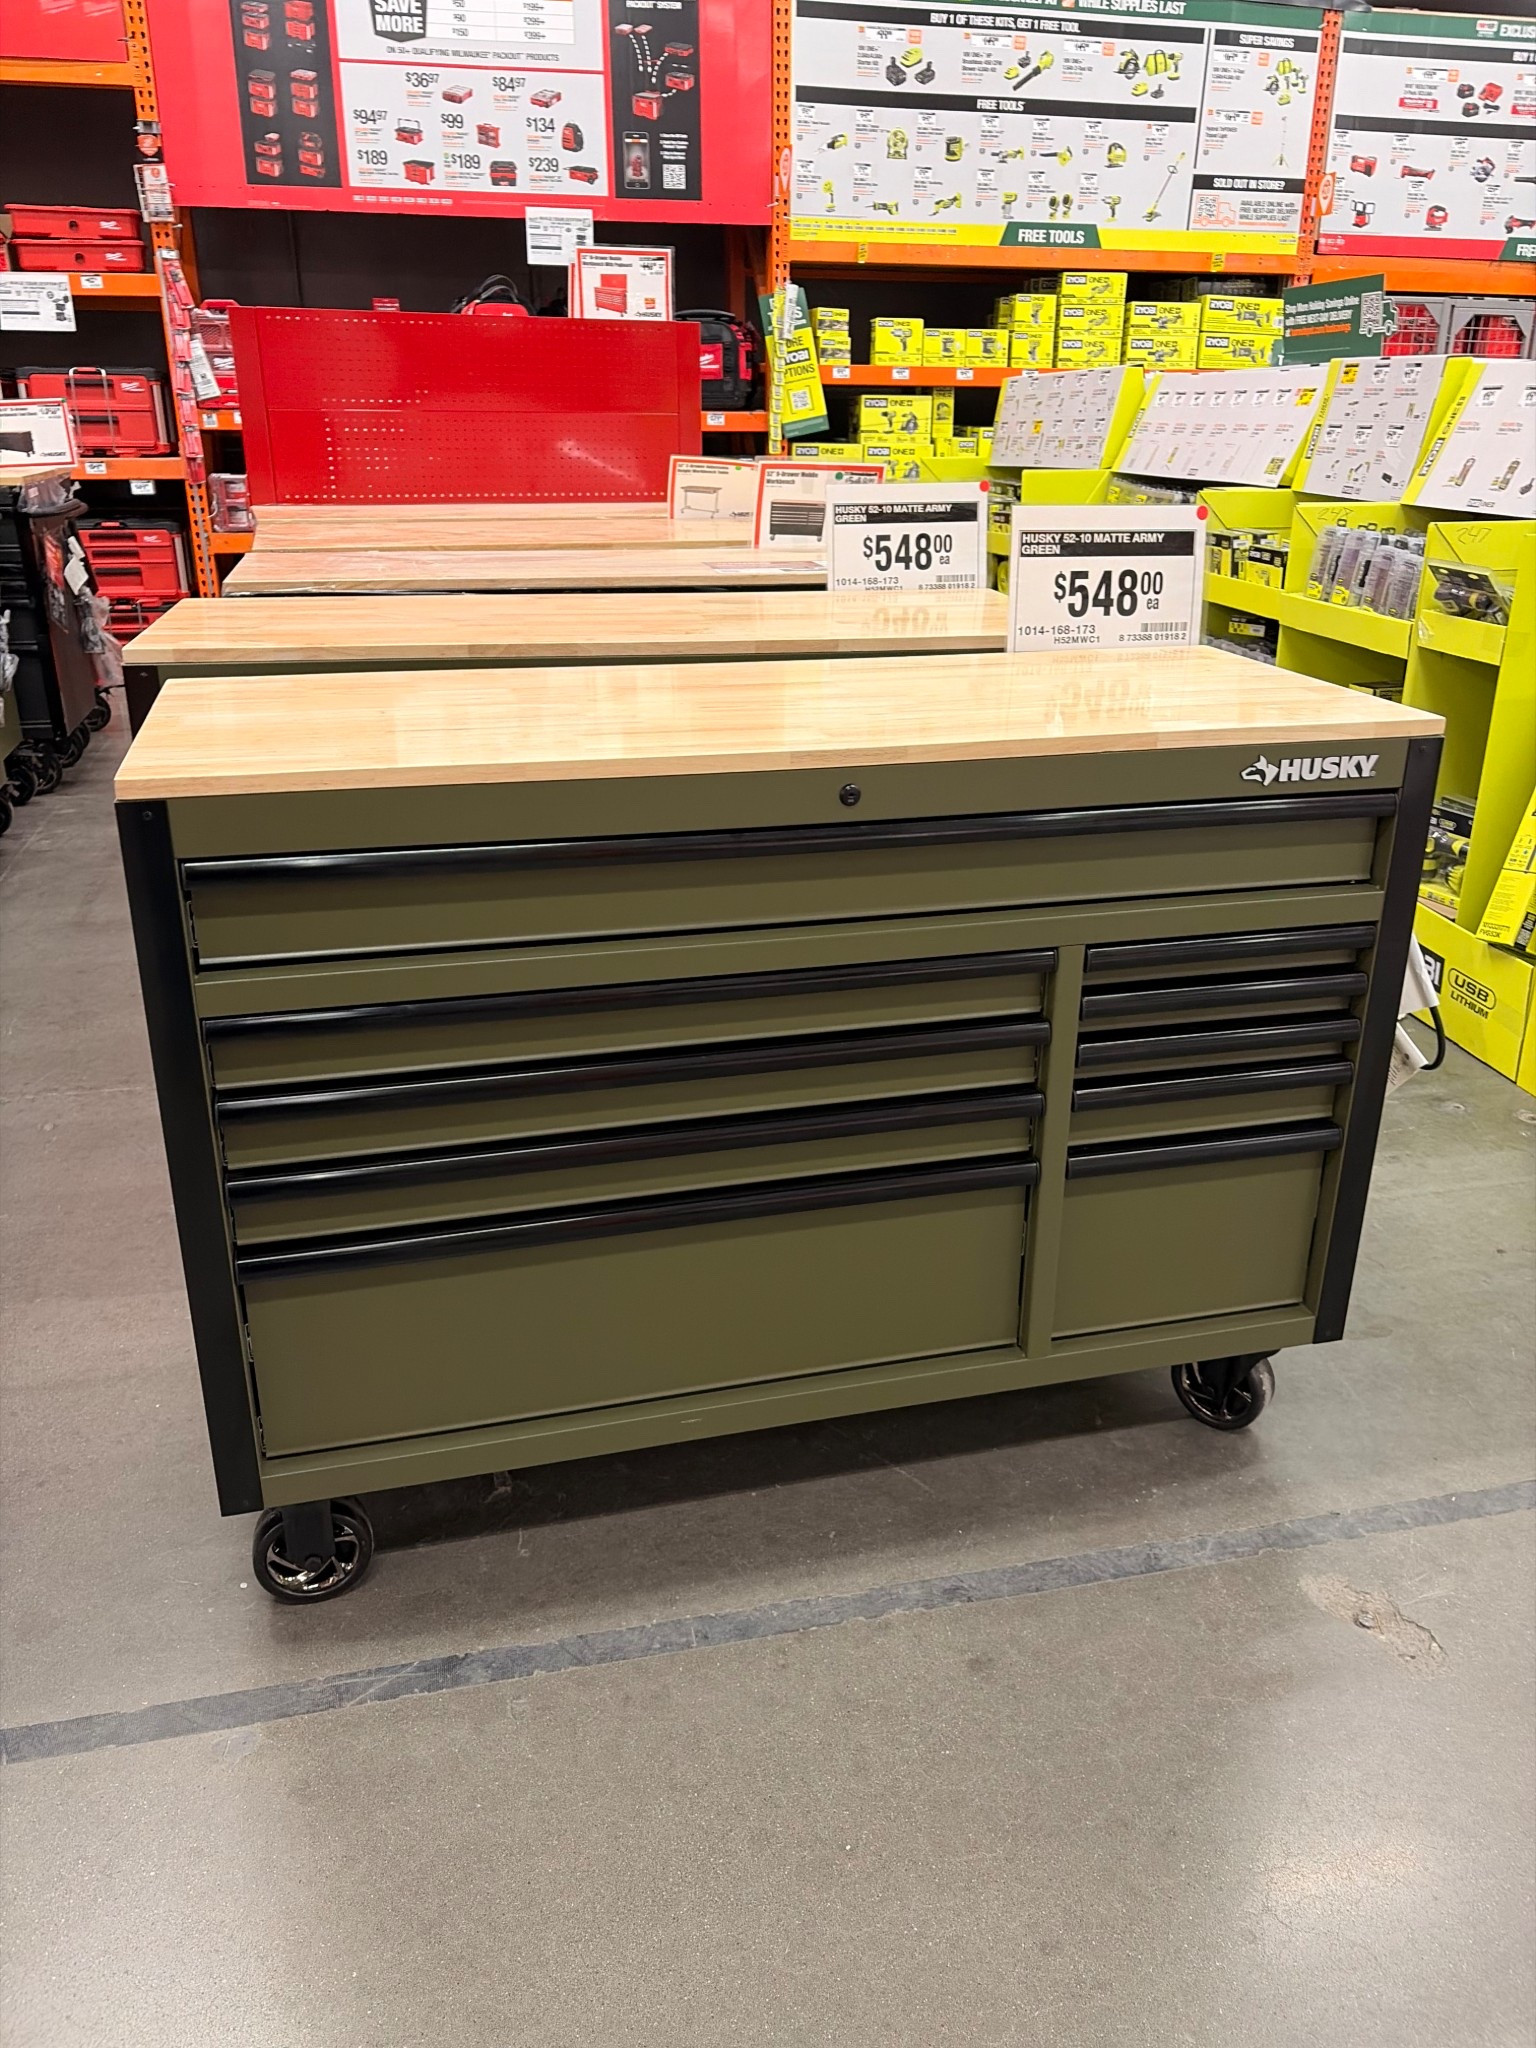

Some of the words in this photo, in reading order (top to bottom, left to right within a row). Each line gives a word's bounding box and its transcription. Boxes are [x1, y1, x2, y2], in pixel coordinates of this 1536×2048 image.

[374, 0, 422, 14] SAVE
[1110, 0, 1158, 13] SUPPLIES
[1159, 1, 1187, 14] LAST
[375, 14, 424, 33] MORE
[930, 12, 948, 23] BUY
[949, 14, 954, 24] 1
[956, 14, 968, 25] OF
[969, 15, 994, 27] THESE
[1017, 18, 1033, 29] GET
[1040, 20, 1060, 31] FREE
[1061, 21, 1081, 33] TOOL
[1239, 34, 1263, 45] SUPER
[1263, 36, 1295, 48] SAVINGS
[977, 99, 998, 110] FREE
[441, 113, 464, 129] $99
[526, 117, 555, 132] $134
[358, 149, 388, 165] $189
[451, 154, 481, 169] $189
[529, 157, 559, 172] $239
[1213, 178, 1233, 188] SOLD
[1234, 179, 1248, 189] OUT
[1018, 229, 1048, 243] FREE
[1050, 230, 1084, 244] TOOLS
[786, 336, 803, 348] ORE
[785, 350, 809, 363] YOBI
[784, 364, 815, 378] PTIONS
[1419, 439, 1445, 475] RYOBI
[835, 506, 867, 514] HUSKY
[868, 505, 892, 513] 52-10
[893, 504, 924, 513] MATTE
[925, 504, 952, 513] ARMY
[1022, 533, 1061, 543] HUSKY
[1063, 533, 1092, 543] 52-10
[1093, 532, 1131, 543] MATTE
[1132, 532, 1164, 543] ARMY
[1456, 526, 1492, 544] 247
[1022, 545, 1060, 555] GREEN
[939, 555, 950, 564] ea
[1146, 598, 1159, 609] ea
[1018, 625, 1096, 635] 1014-168-173
[1155, 633, 1180, 641] 01918
[1053, 636, 1100, 644] H52MWC1
[1278, 755, 1380, 782] HUSKY
[1454, 974, 1489, 1003] USB
[1451, 990, 1489, 1019] LITHIUM
